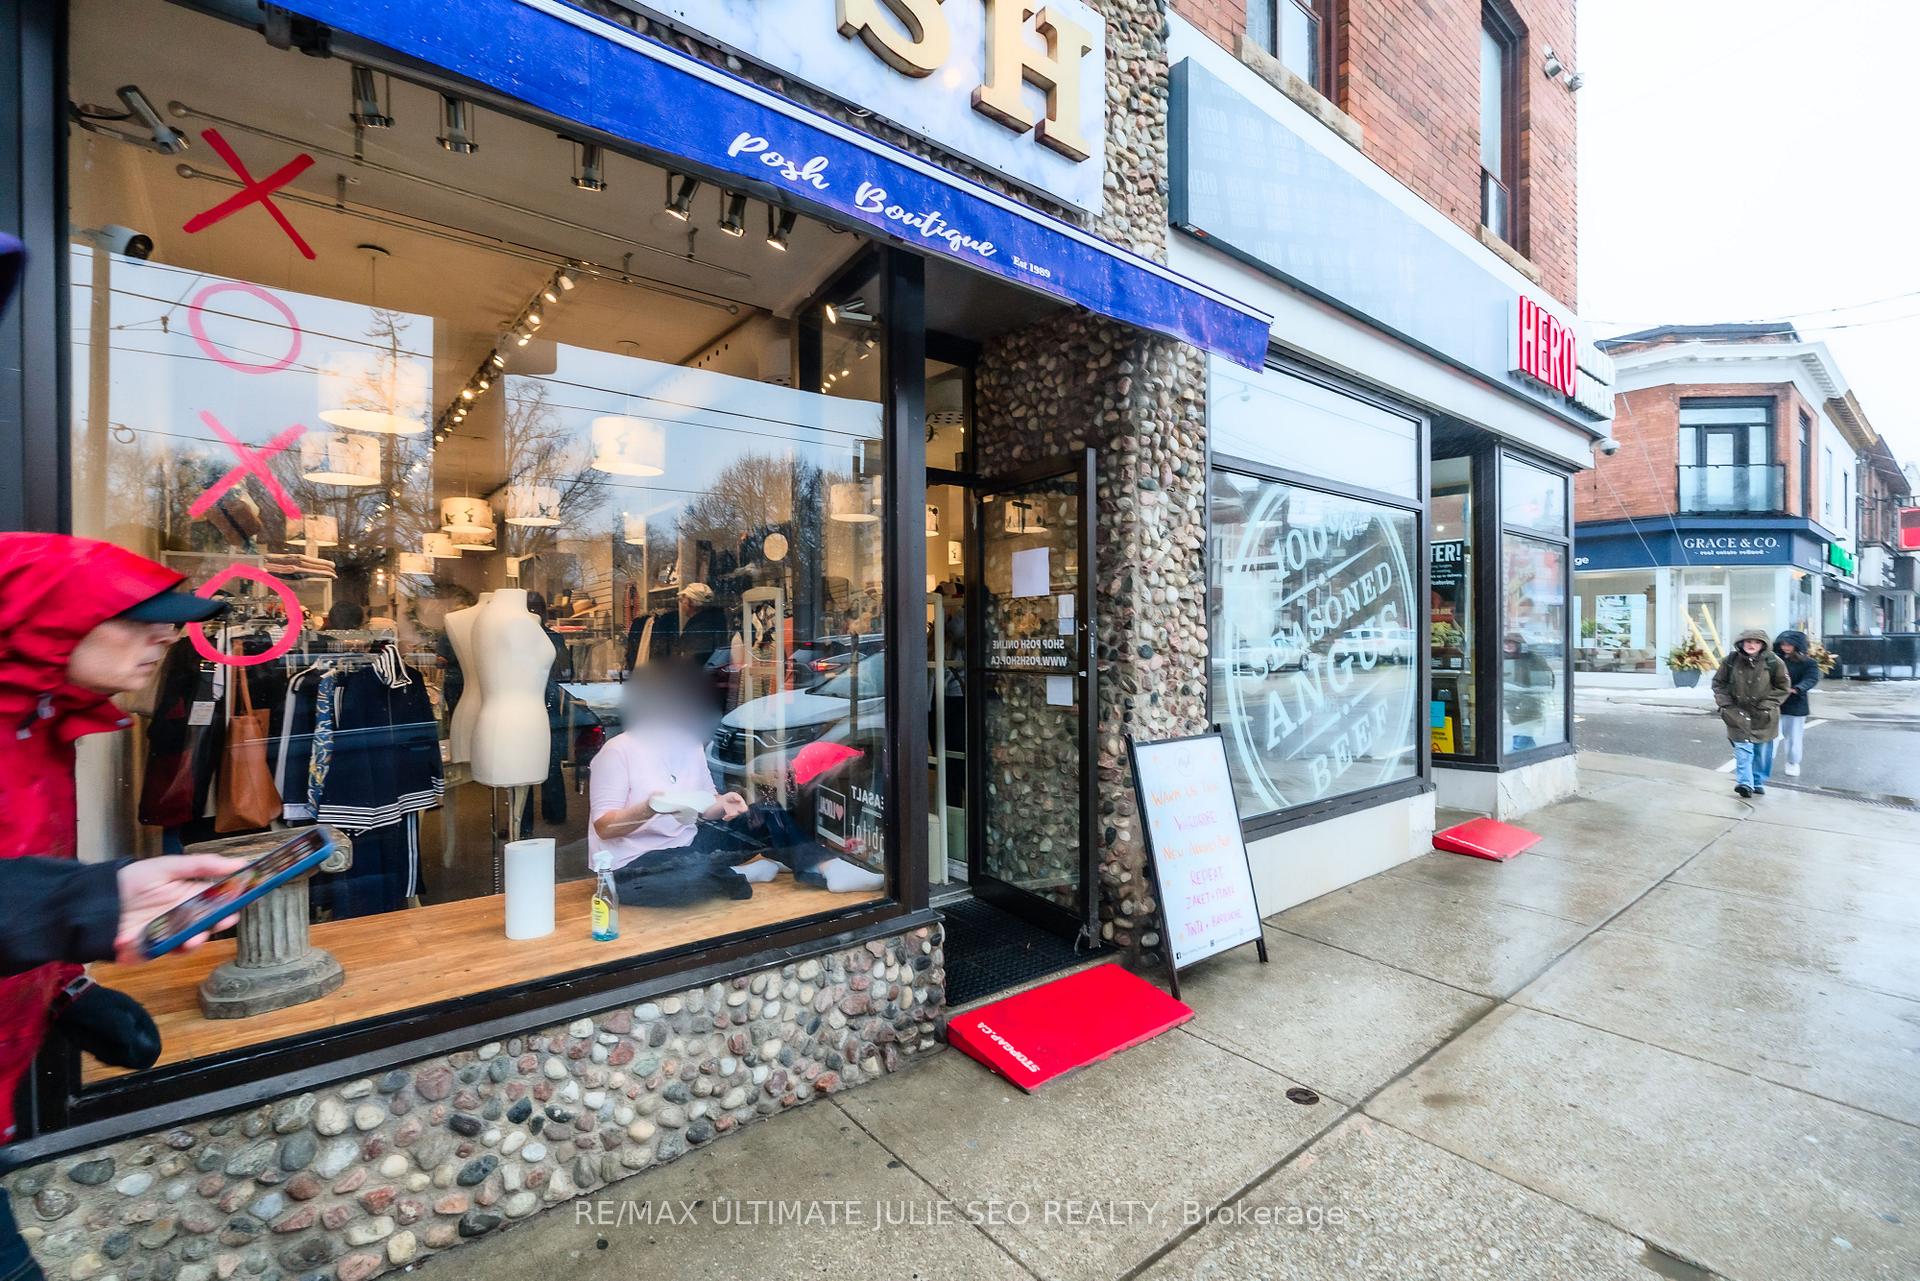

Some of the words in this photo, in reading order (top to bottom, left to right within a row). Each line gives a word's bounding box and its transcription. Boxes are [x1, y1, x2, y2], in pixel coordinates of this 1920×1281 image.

[727, 131, 830, 190] Posh
[854, 181, 998, 257] Boutique
[1011, 255, 1028, 270] Est
[1029, 262, 1051, 278] 1989
[1519, 295, 1577, 398] HERO
[1683, 537, 1737, 549] GRACE
[1740, 538, 1751, 548] &
[1753, 537, 1780, 548] CO.
[1266, 601, 1399, 751] ANGUS
[1308, 698, 1389, 798] BEEF
[977, 1022, 1040, 1072] STOPGAP.CA
